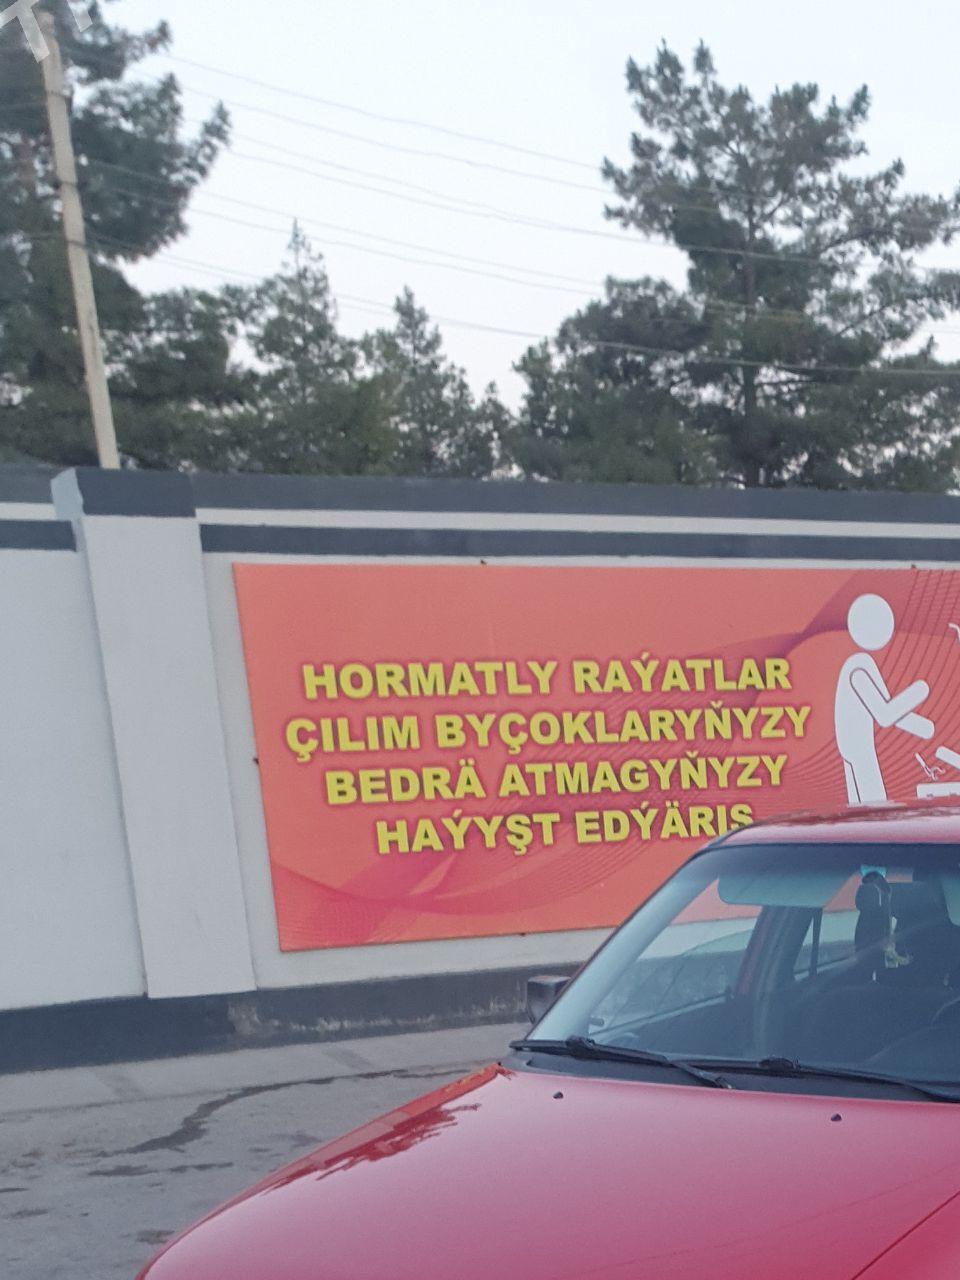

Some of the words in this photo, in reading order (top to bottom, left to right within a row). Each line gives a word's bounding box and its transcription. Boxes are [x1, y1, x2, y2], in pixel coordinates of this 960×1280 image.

[303, 661, 557, 700] HORMATLY
[572, 652, 792, 694] RAÝATLAR
[285, 716, 420, 762] ÇILIM
[435, 701, 812, 753] BYÇOKLARYŇYZY
[325, 760, 486, 805] BEDRÄ
[498, 751, 788, 798] ATMAGYŇYZY
[376, 810, 561, 855] HAÝYŞT
[574, 801, 753, 844] EDÝÄRIS
